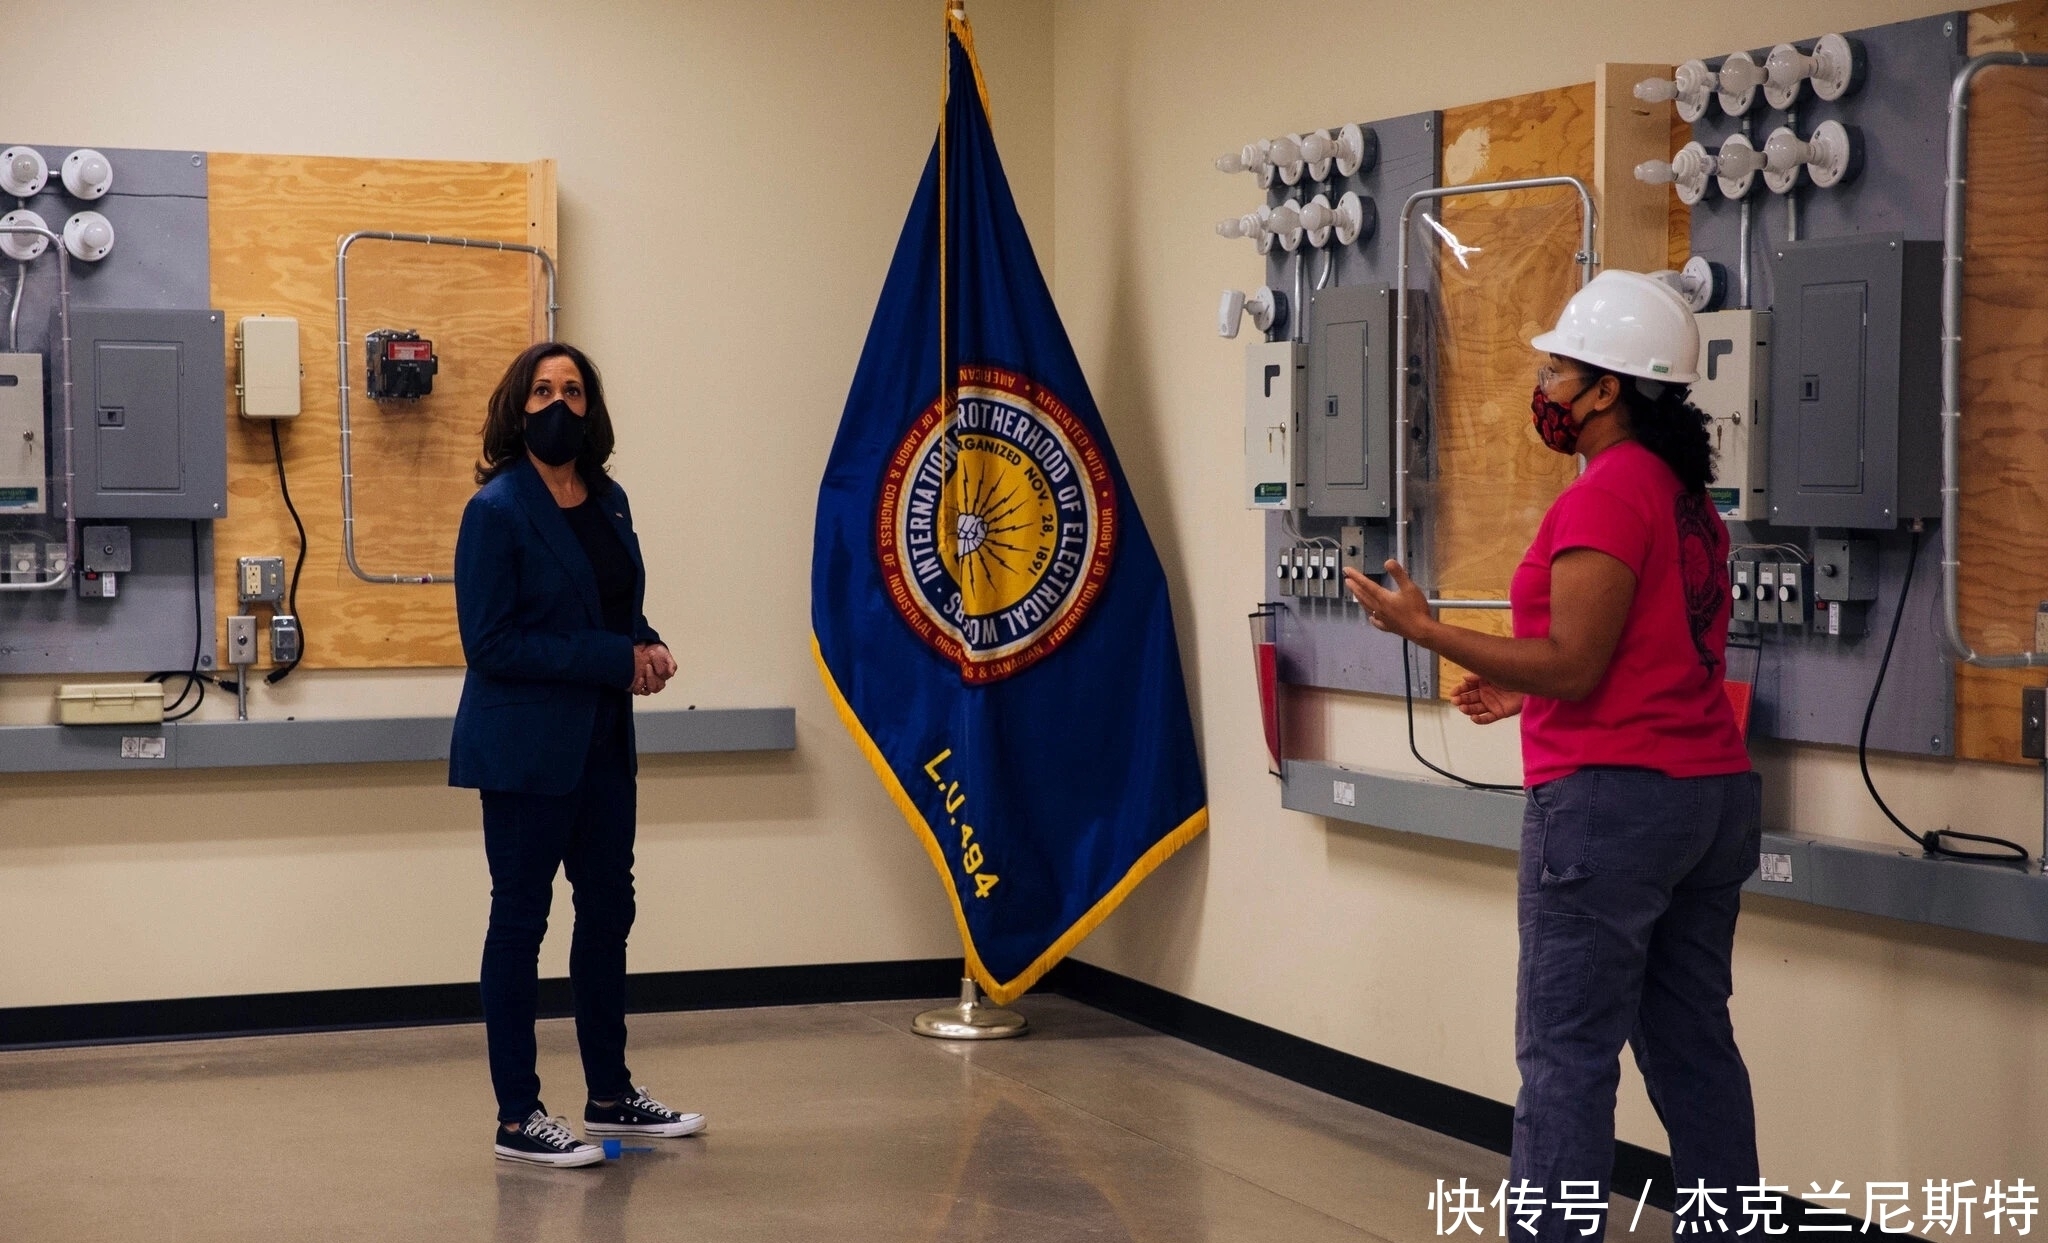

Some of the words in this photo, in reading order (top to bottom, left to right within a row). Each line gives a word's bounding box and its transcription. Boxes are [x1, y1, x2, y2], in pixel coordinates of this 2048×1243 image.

[960, 369, 1016, 388] AMERICAN
[921, 413, 934, 430] OF
[1036, 391, 1089, 448] AFFILIATED
[1084, 446, 1107, 482] WITH
[895, 429, 922, 467] LABOR
[957, 401, 1070, 484] ROTHERHOOD
[957, 437, 1022, 467] RGANIZED
[889, 468, 902, 479] &
[1024, 466, 1050, 507] NOV.
[909, 430, 959, 585] INTERNATION
[1057, 485, 1082, 512] OF
[880, 483, 898, 548] CONGRESS
[1039, 513, 1055, 538] 28,
[1098, 507, 1113, 556] LABOUR
[882, 553, 897, 568] OF
[1027, 545, 1051, 577] 1891
[1092, 559, 1107, 576] OF
[1000, 522, 1084, 636] ELECTRICAL
[888, 573, 934, 639] INDUSTRIAL
[1048, 581, 1099, 646] FEDERATION
[978, 666, 988, 678] &
[990, 644, 1044, 677] CANADIAN
